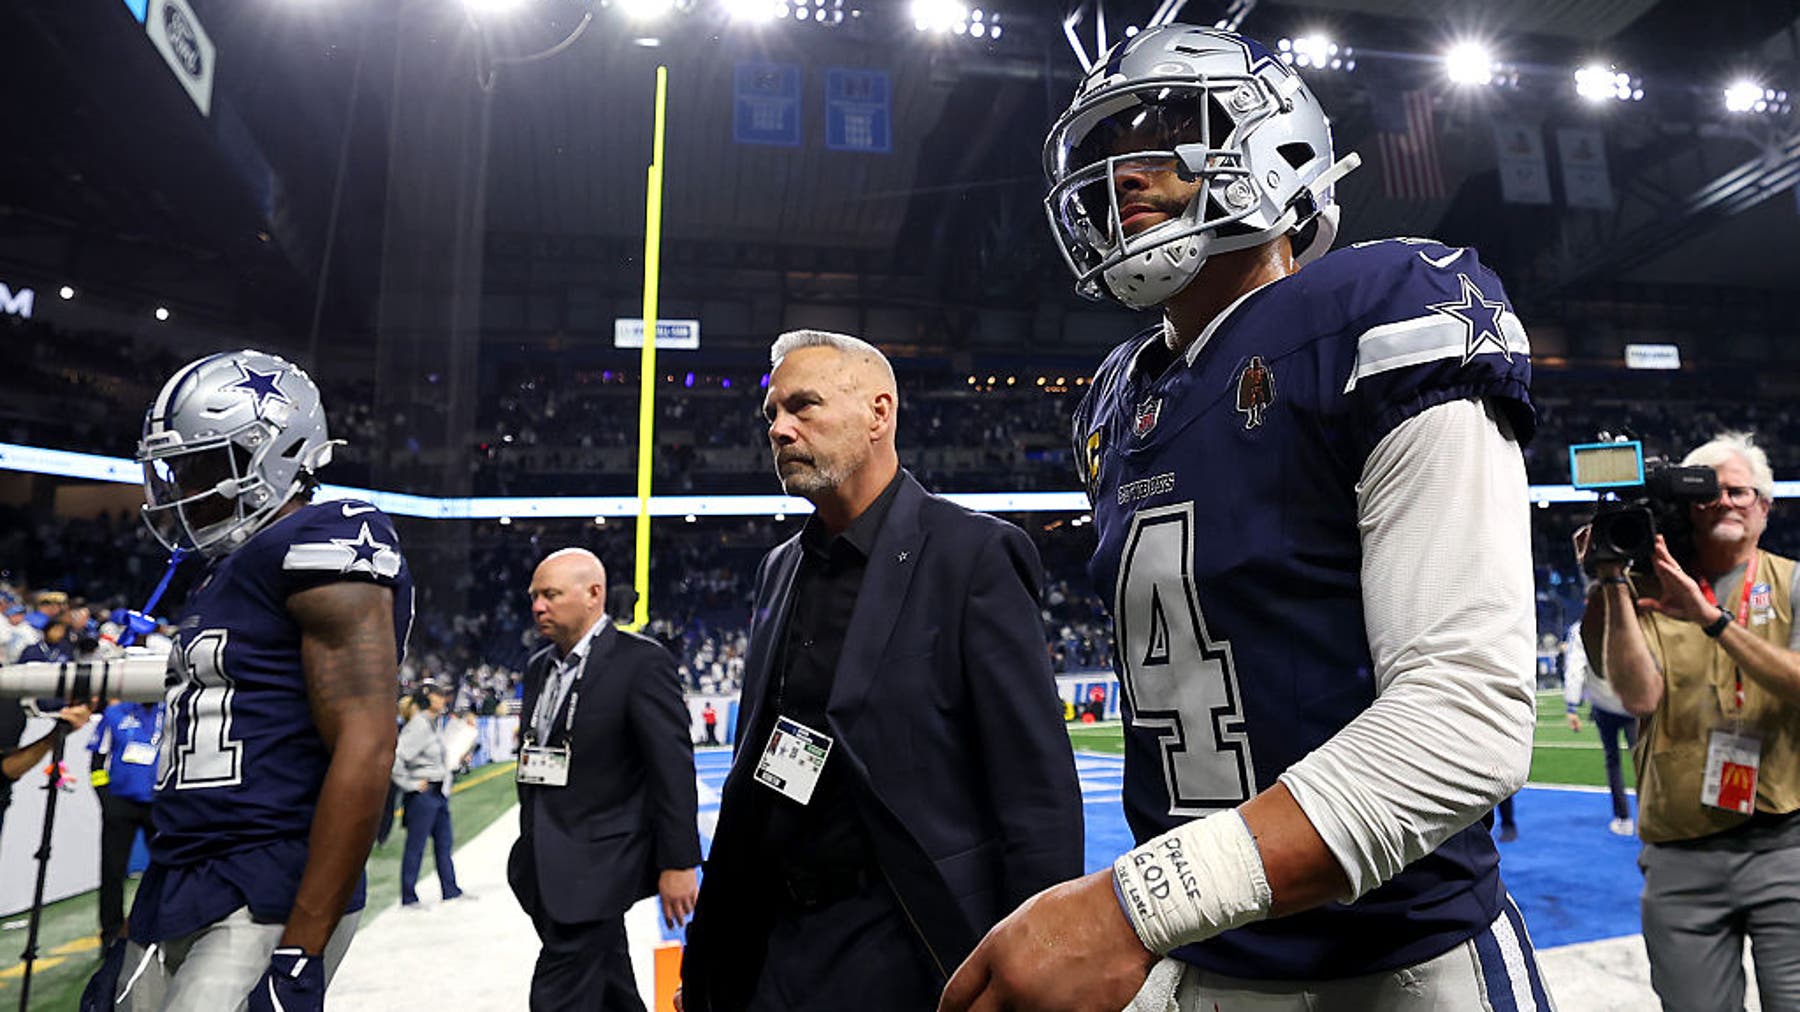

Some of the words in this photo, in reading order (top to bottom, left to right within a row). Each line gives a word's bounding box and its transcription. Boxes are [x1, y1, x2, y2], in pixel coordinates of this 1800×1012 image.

[1113, 500, 1258, 818] 4
[1133, 851, 1170, 900] GOD
[1156, 837, 1202, 901] PRAISE
